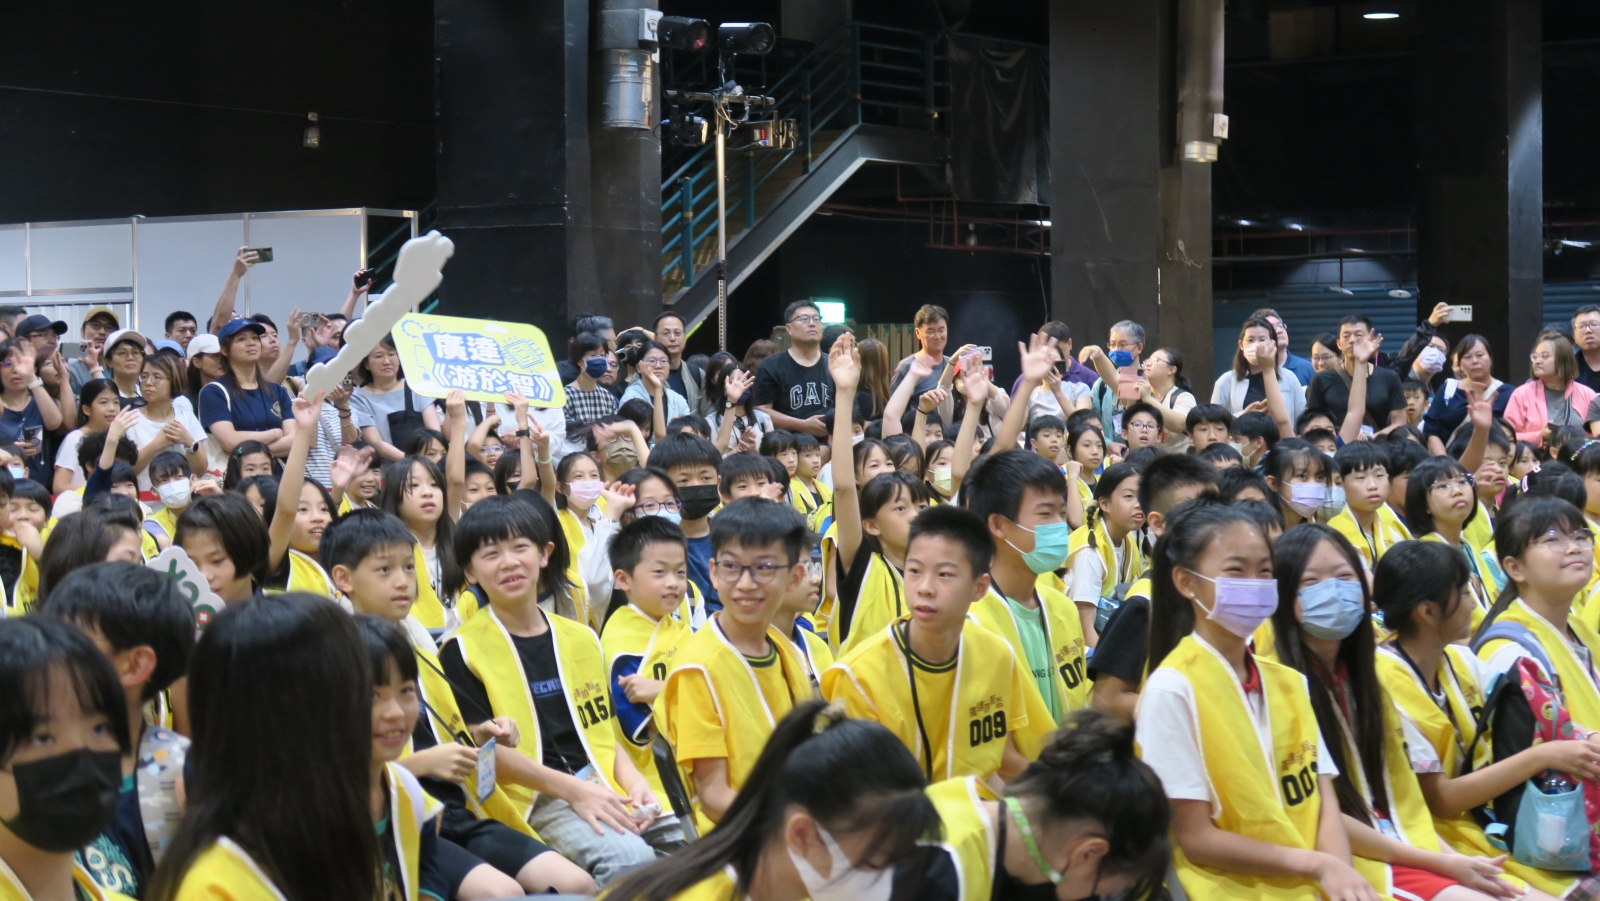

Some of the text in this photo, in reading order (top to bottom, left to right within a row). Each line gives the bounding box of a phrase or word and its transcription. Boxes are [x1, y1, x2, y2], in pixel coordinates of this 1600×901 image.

[432, 333, 503, 365] 廣達
[577, 695, 609, 730] 015
[970, 710, 1007, 748] 009
